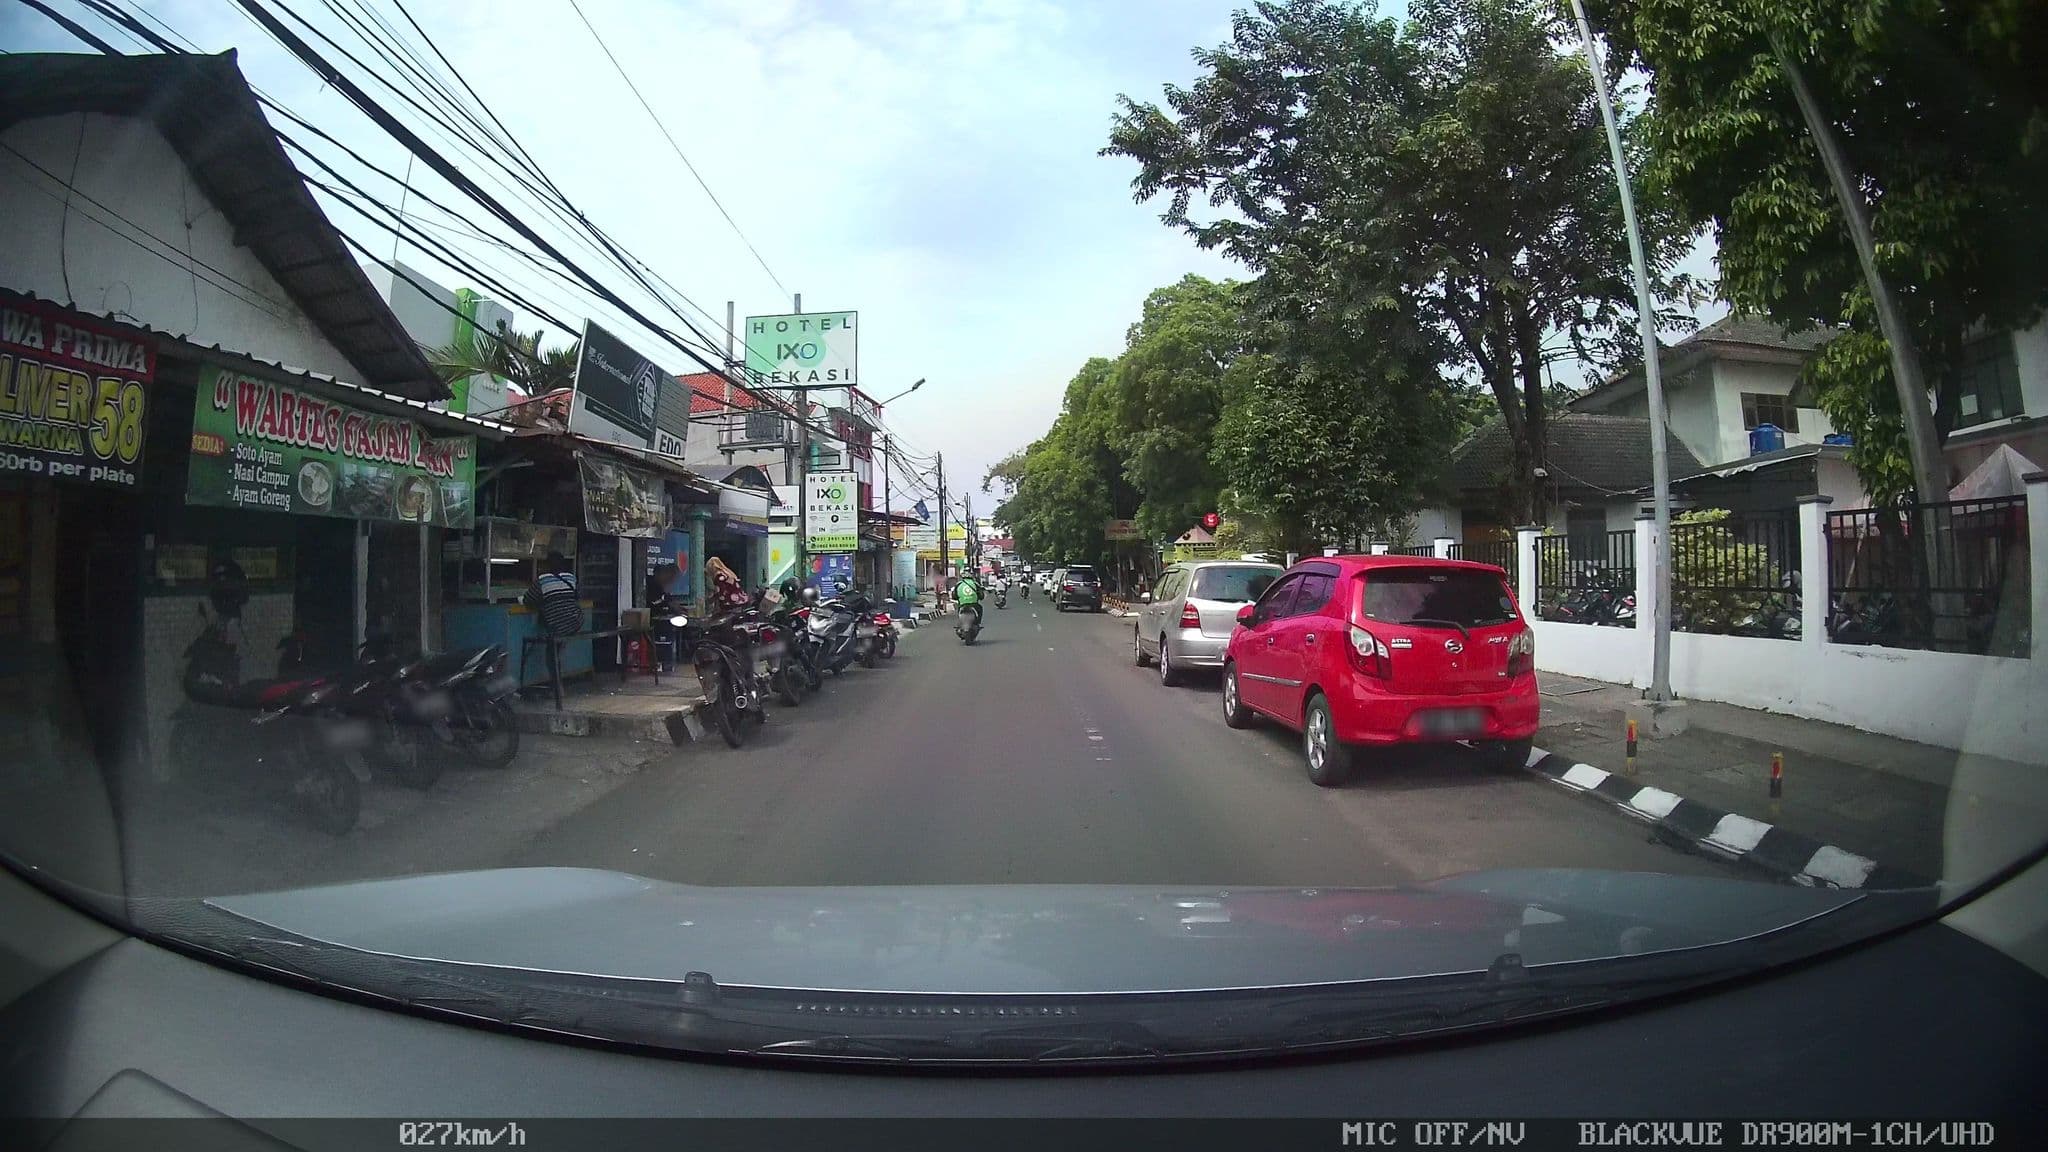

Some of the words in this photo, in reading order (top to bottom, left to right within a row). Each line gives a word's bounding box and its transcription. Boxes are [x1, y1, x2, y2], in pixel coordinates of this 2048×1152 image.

[753, 318, 851, 334] HOTEL
[52, 322, 147, 373] PRIMA
[777, 343, 818, 360] IXO
[753, 369, 849, 384] BEKASI
[89, 376, 145, 465] 58
[343, 411, 411, 465] FAJAR
[236, 443, 257, 460] Soto
[258, 447, 282, 467] Ayam
[49, 461, 86, 477] per
[90, 465, 135, 485] plate
[234, 463, 255, 482] Nasi
[256, 467, 290, 489] Campur
[232, 485, 258, 506] Ayam
[260, 488, 291, 511] Goreng
[817, 489, 841, 499] IXO
